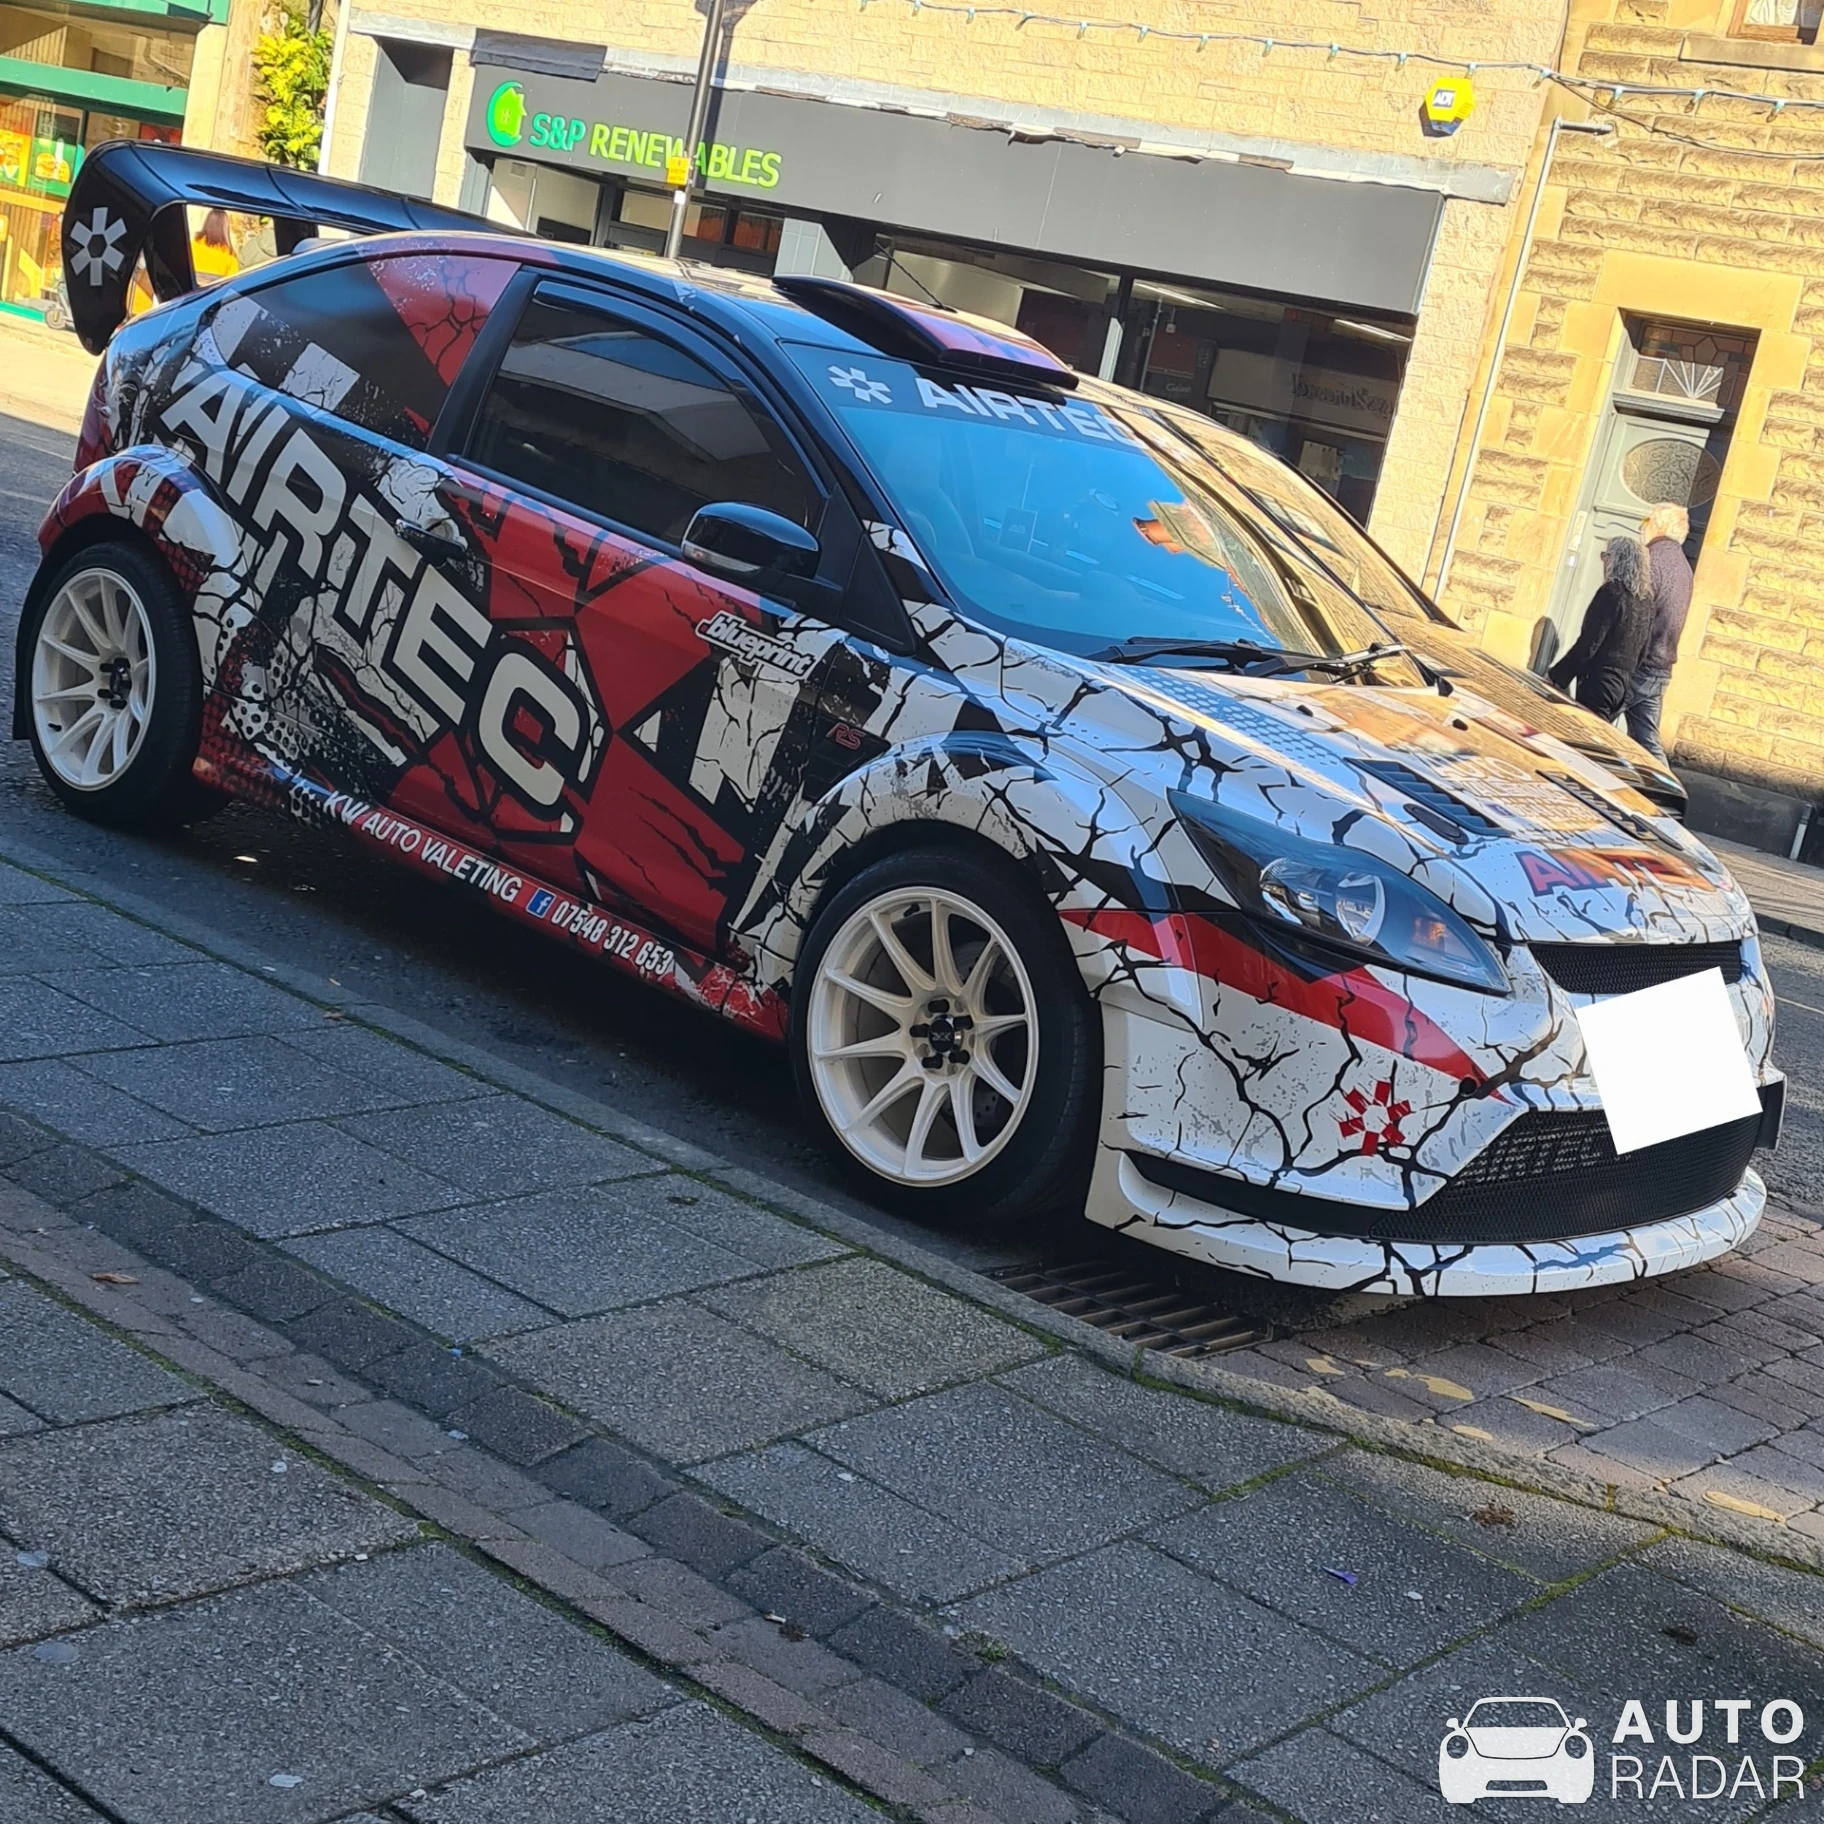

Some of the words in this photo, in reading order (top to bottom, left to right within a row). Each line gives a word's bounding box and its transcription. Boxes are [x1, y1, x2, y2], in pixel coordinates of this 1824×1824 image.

[1433, 91, 1455, 107] ADT
[529, 112, 586, 151] S&P
[160, 370, 580, 806] AIRTEC
[705, 615, 816, 674] blueprint
[826, 722, 867, 750] RS
[323, 790, 369, 825] KW
[362, 810, 421, 852] AUTO
[420, 837, 522, 902] VALETING
[551, 901, 607, 944] 07548
[604, 927, 640, 960] 312
[636, 943, 674, 975] 653
